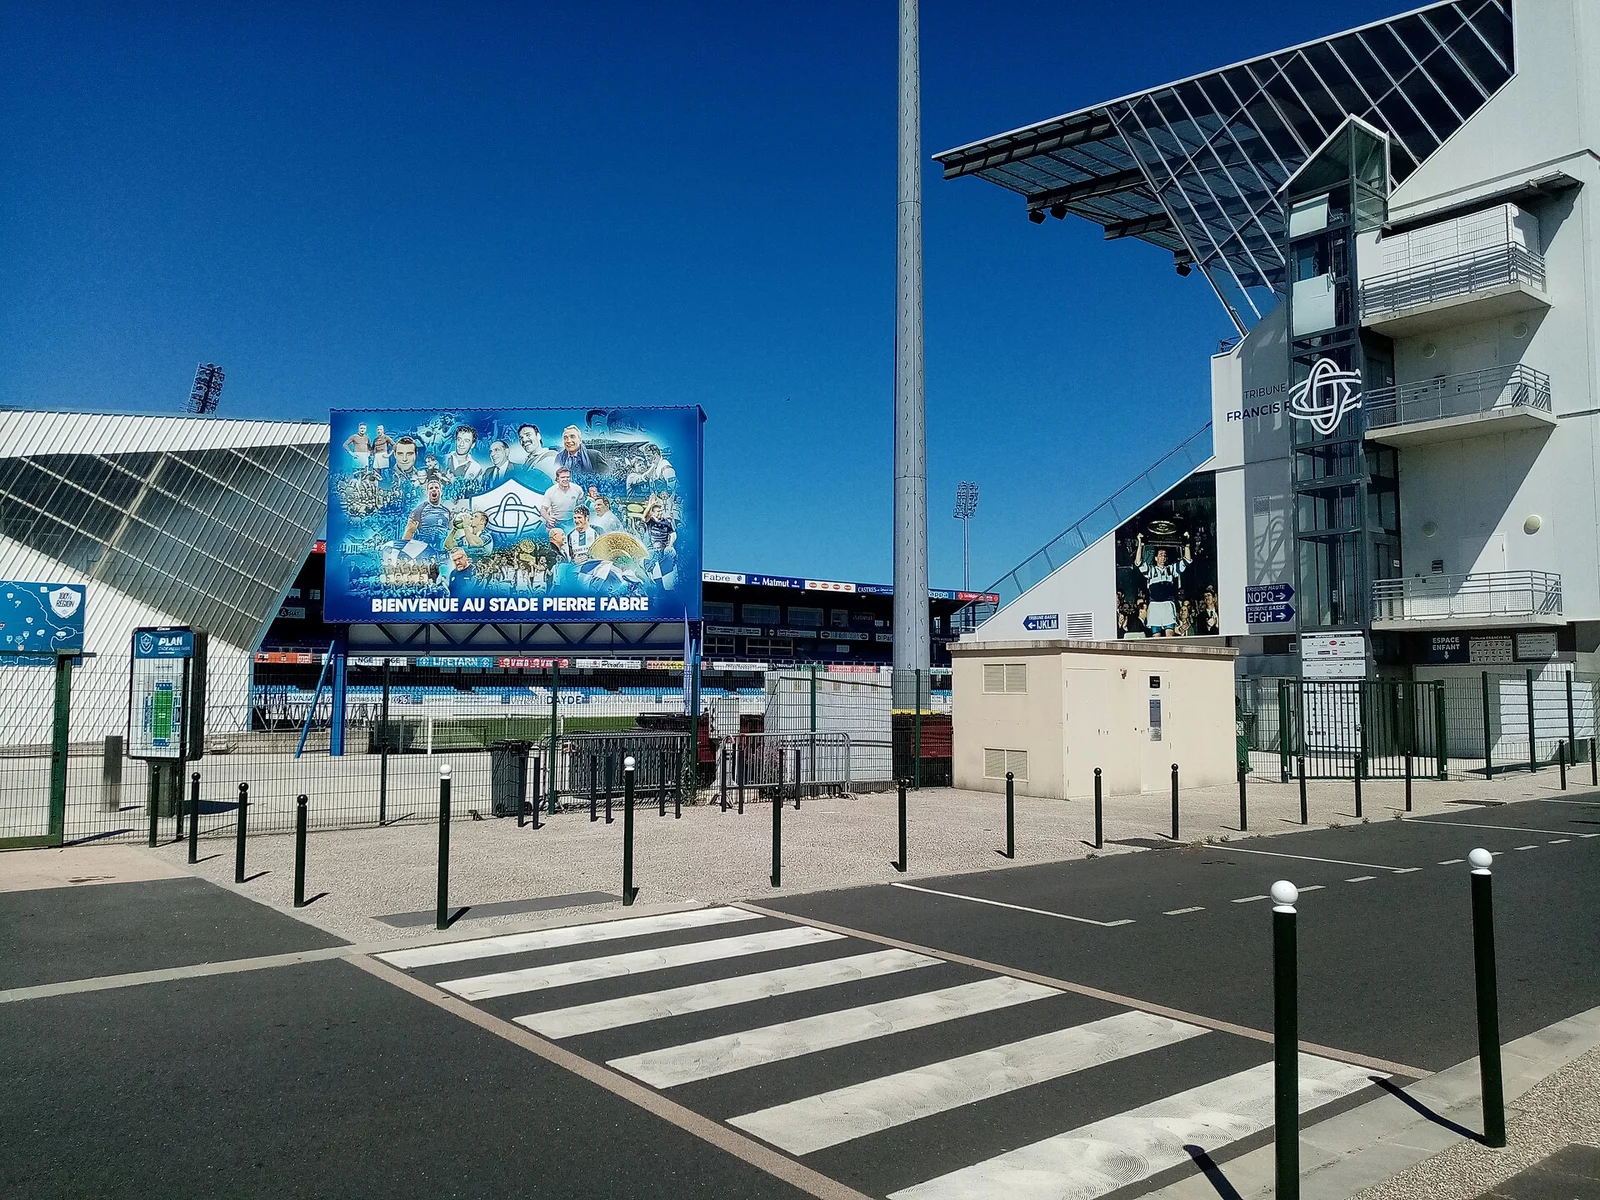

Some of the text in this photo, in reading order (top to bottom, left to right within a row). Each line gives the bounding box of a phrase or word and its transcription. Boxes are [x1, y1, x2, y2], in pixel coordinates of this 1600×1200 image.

[1243, 383, 1287, 400] TRIBUNE
[1226, 402, 1280, 423] FRANCIS
[702, 573, 731, 583] Fabre
[761, 577, 790, 588] Matmut
[1247, 591, 1275, 603] NOPQ
[371, 597, 649, 613] BIENVENUE AU STADE PIERRE FABRE
[1247, 611, 1273, 623] EFGH
[1036, 619, 1057, 630] IJKLM
[158, 636, 183, 646] PLAN
